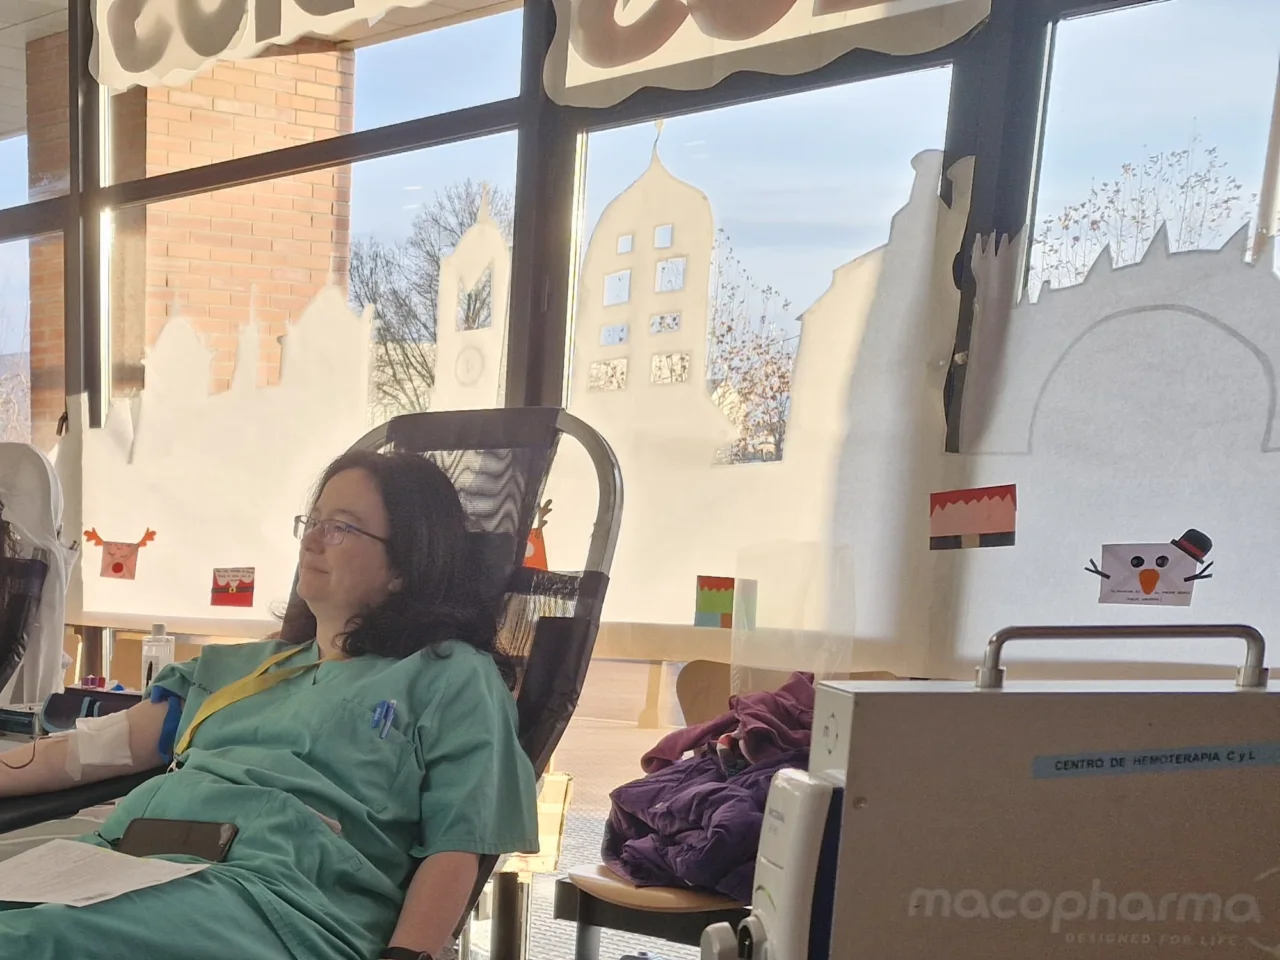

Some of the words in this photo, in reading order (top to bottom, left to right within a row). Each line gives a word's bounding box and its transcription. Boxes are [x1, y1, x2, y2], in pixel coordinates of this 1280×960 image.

[1054, 757, 1104, 771] CENTRO
[1110, 756, 1126, 769] DE
[1133, 751, 1221, 766] HEMOTERAPIA
[1226, 750, 1236, 761] C
[1238, 752, 1245, 763] y
[1249, 750, 1256, 760] L
[907, 878, 1263, 934] macopharma
[1065, 932, 1151, 946] DESIGNED
[1159, 933, 1192, 946] FOR
[1200, 933, 1238, 946] LIFE
